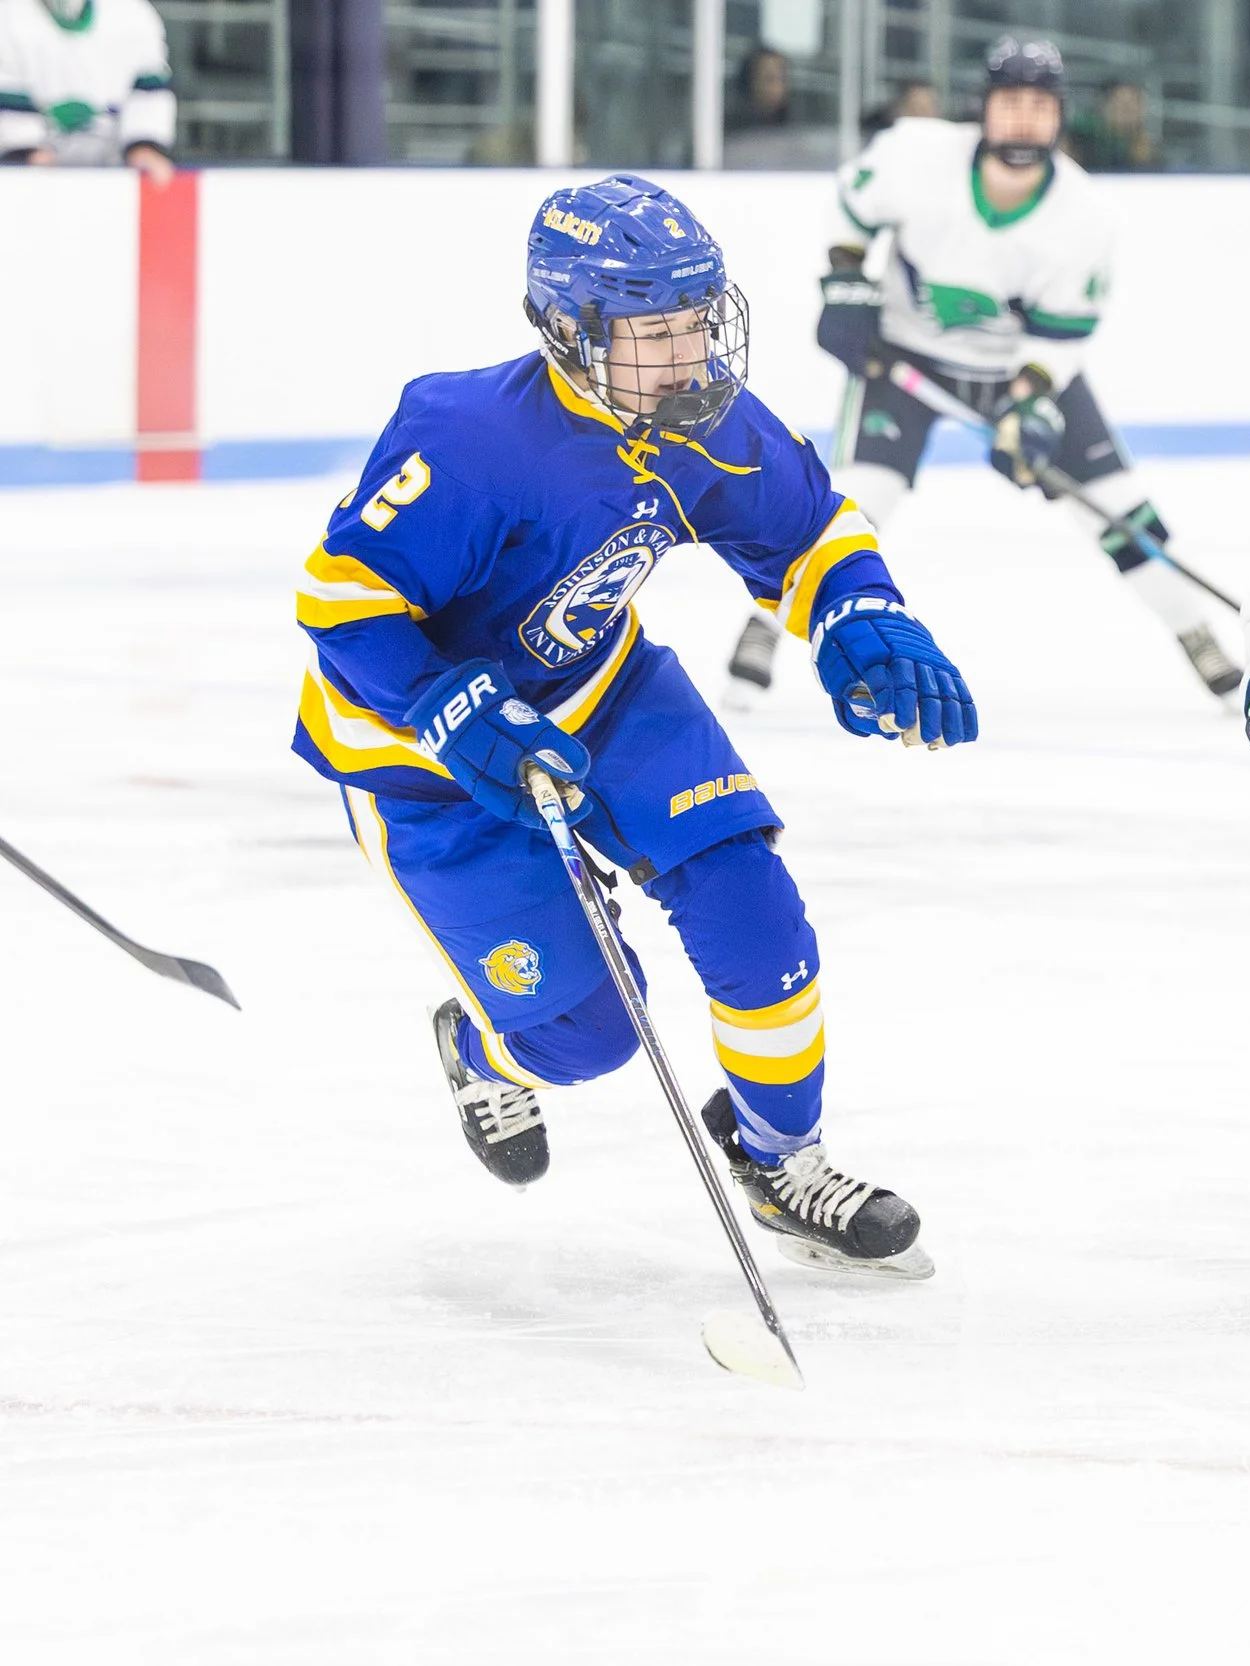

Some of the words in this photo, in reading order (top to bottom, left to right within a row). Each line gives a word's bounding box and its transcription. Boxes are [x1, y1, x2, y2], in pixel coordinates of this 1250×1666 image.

[543, 207, 603, 246] WILDCATS
[664, 217, 686, 239] 2
[360, 451, 431, 532] 2
[544, 532, 630, 608] JOHNSON
[633, 528, 647, 544] &
[418, 672, 498, 762] AUER
